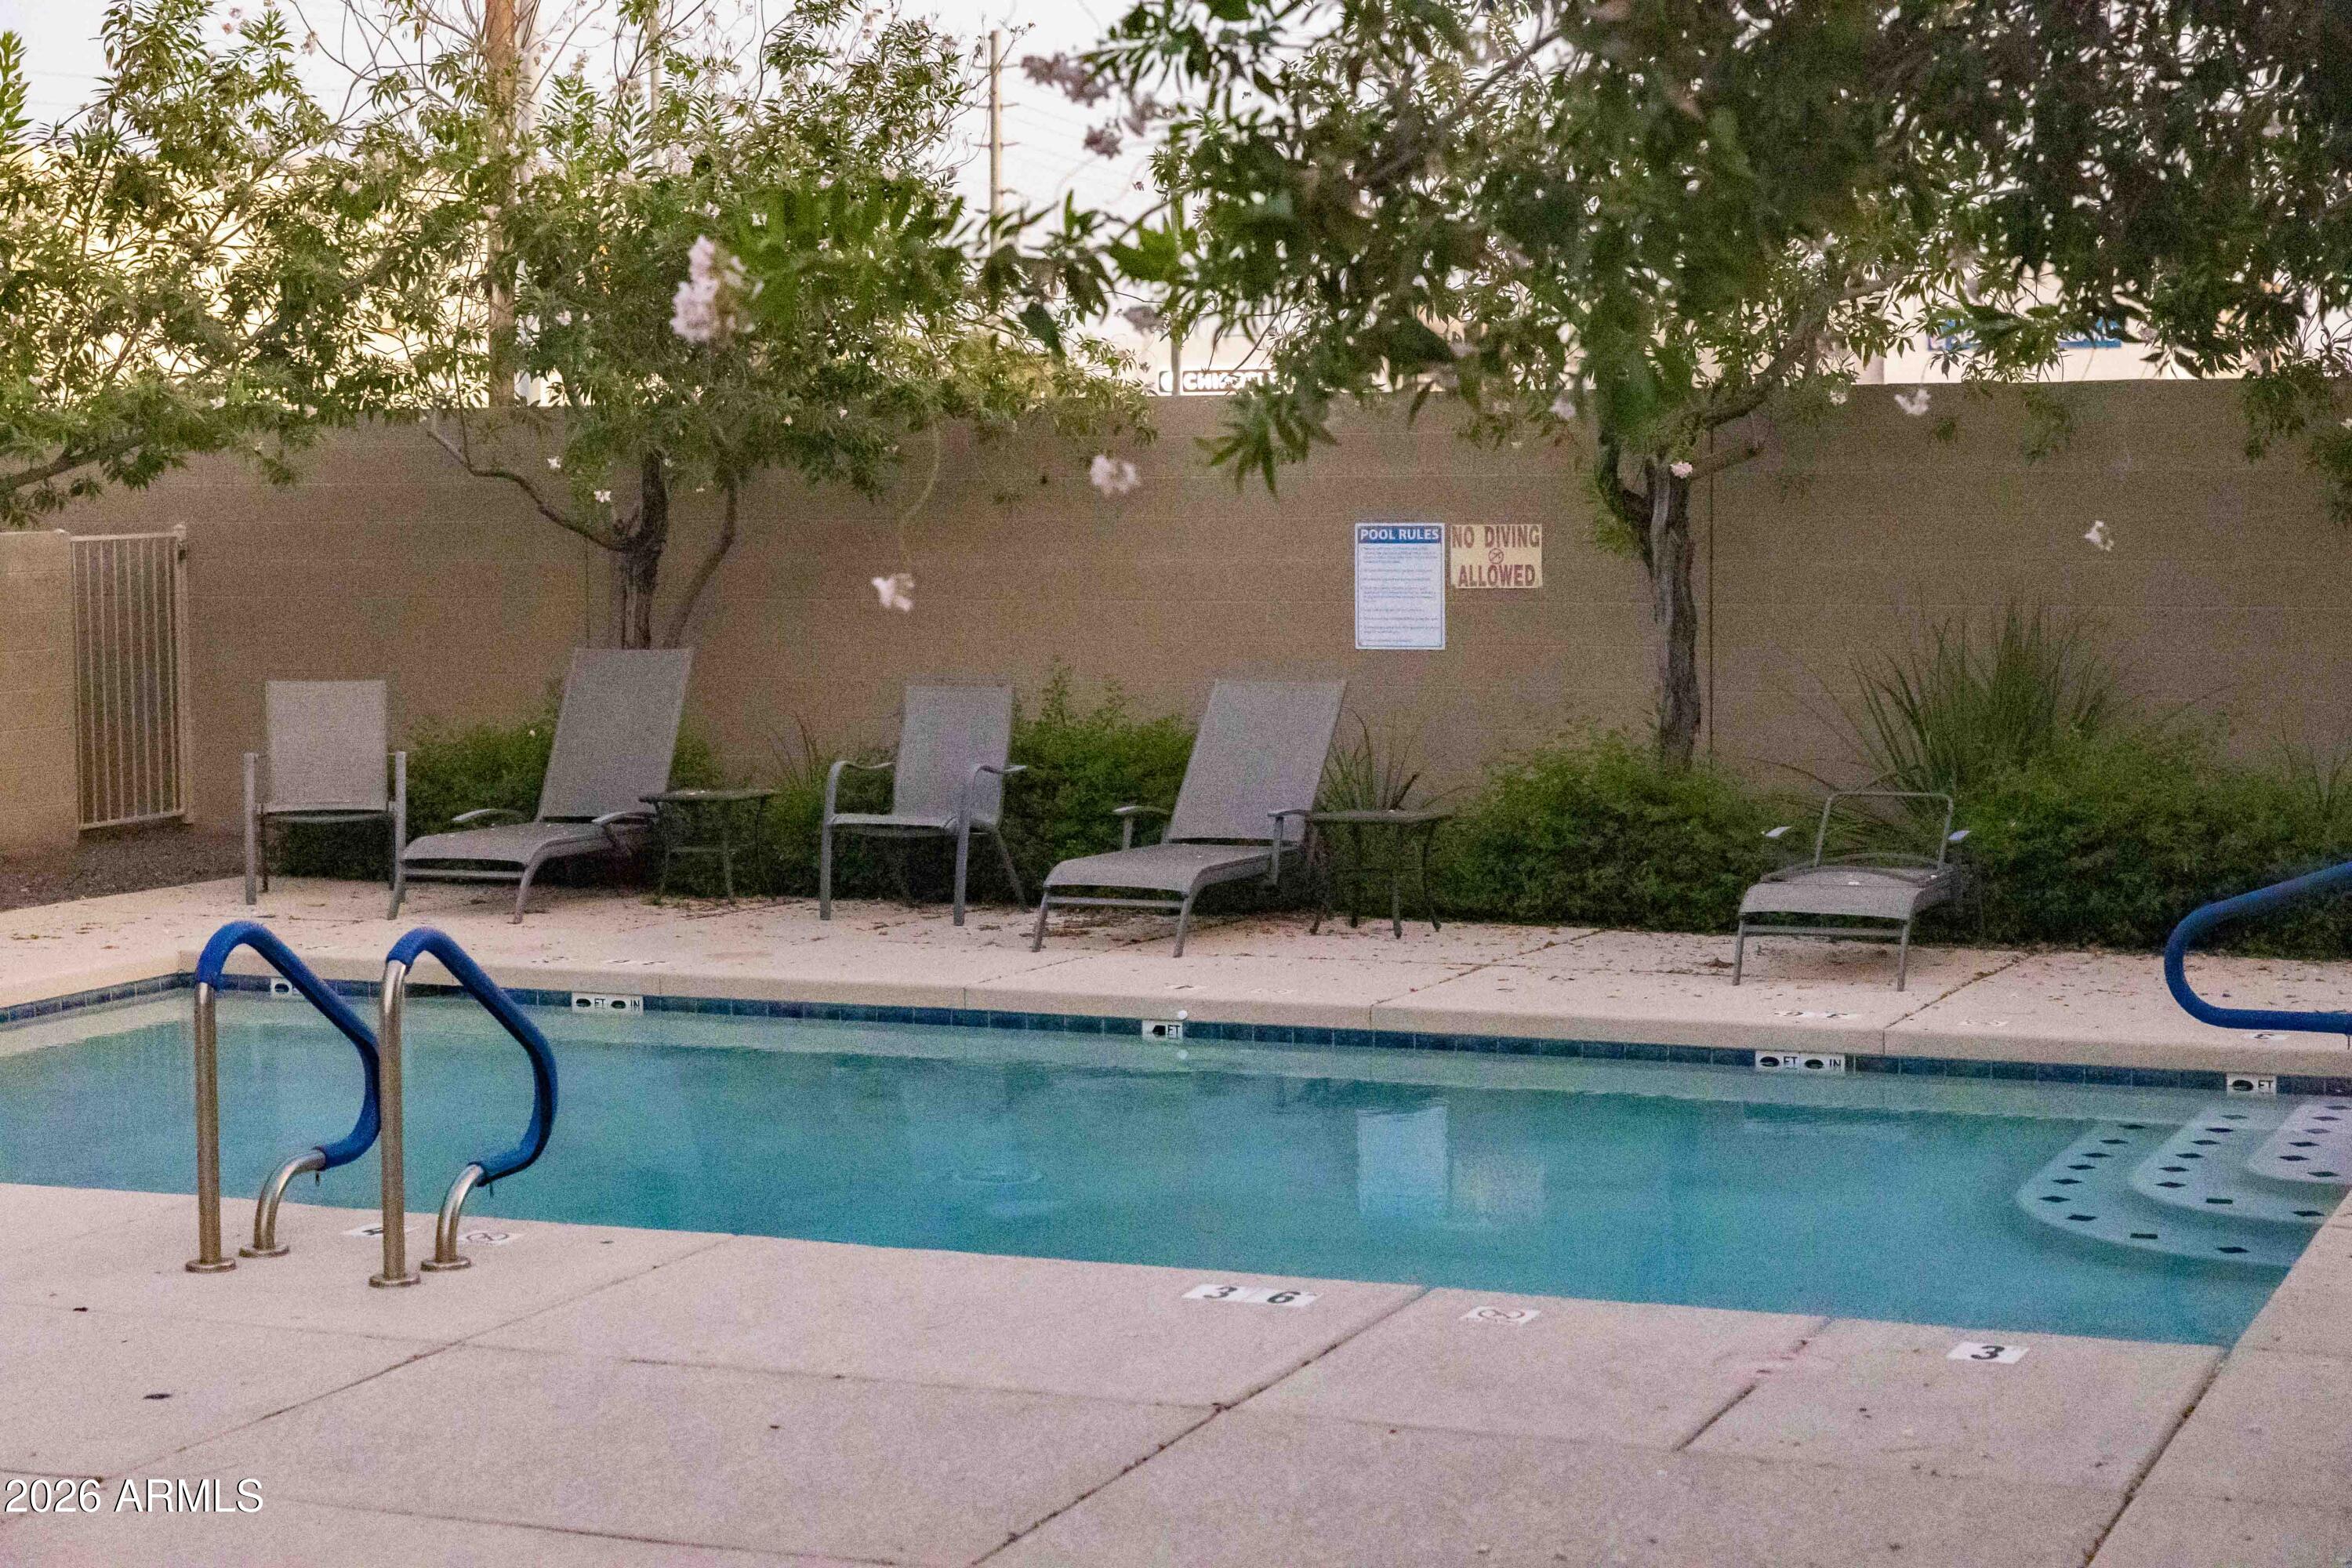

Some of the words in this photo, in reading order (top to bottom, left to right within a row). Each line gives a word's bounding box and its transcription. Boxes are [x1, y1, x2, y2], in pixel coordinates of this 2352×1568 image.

[1360, 528, 1396, 540] POOL
[1399, 528, 1439, 540] RULES
[1451, 525, 1475, 548] NO
[1484, 524, 1540, 548] DIVING
[1459, 564, 1536, 586] ALLOWED
[594, 998, 606, 1007] FT
[1167, 1025, 1181, 1035] FT
[1783, 1056, 1798, 1065] FT
[1829, 1058, 1842, 1067] IN
[2258, 1080, 2274, 1089] FT
[1203, 1286, 1238, 1299] 3
[1266, 1290, 1301, 1304] 6
[1970, 1345, 2005, 1360] 3
